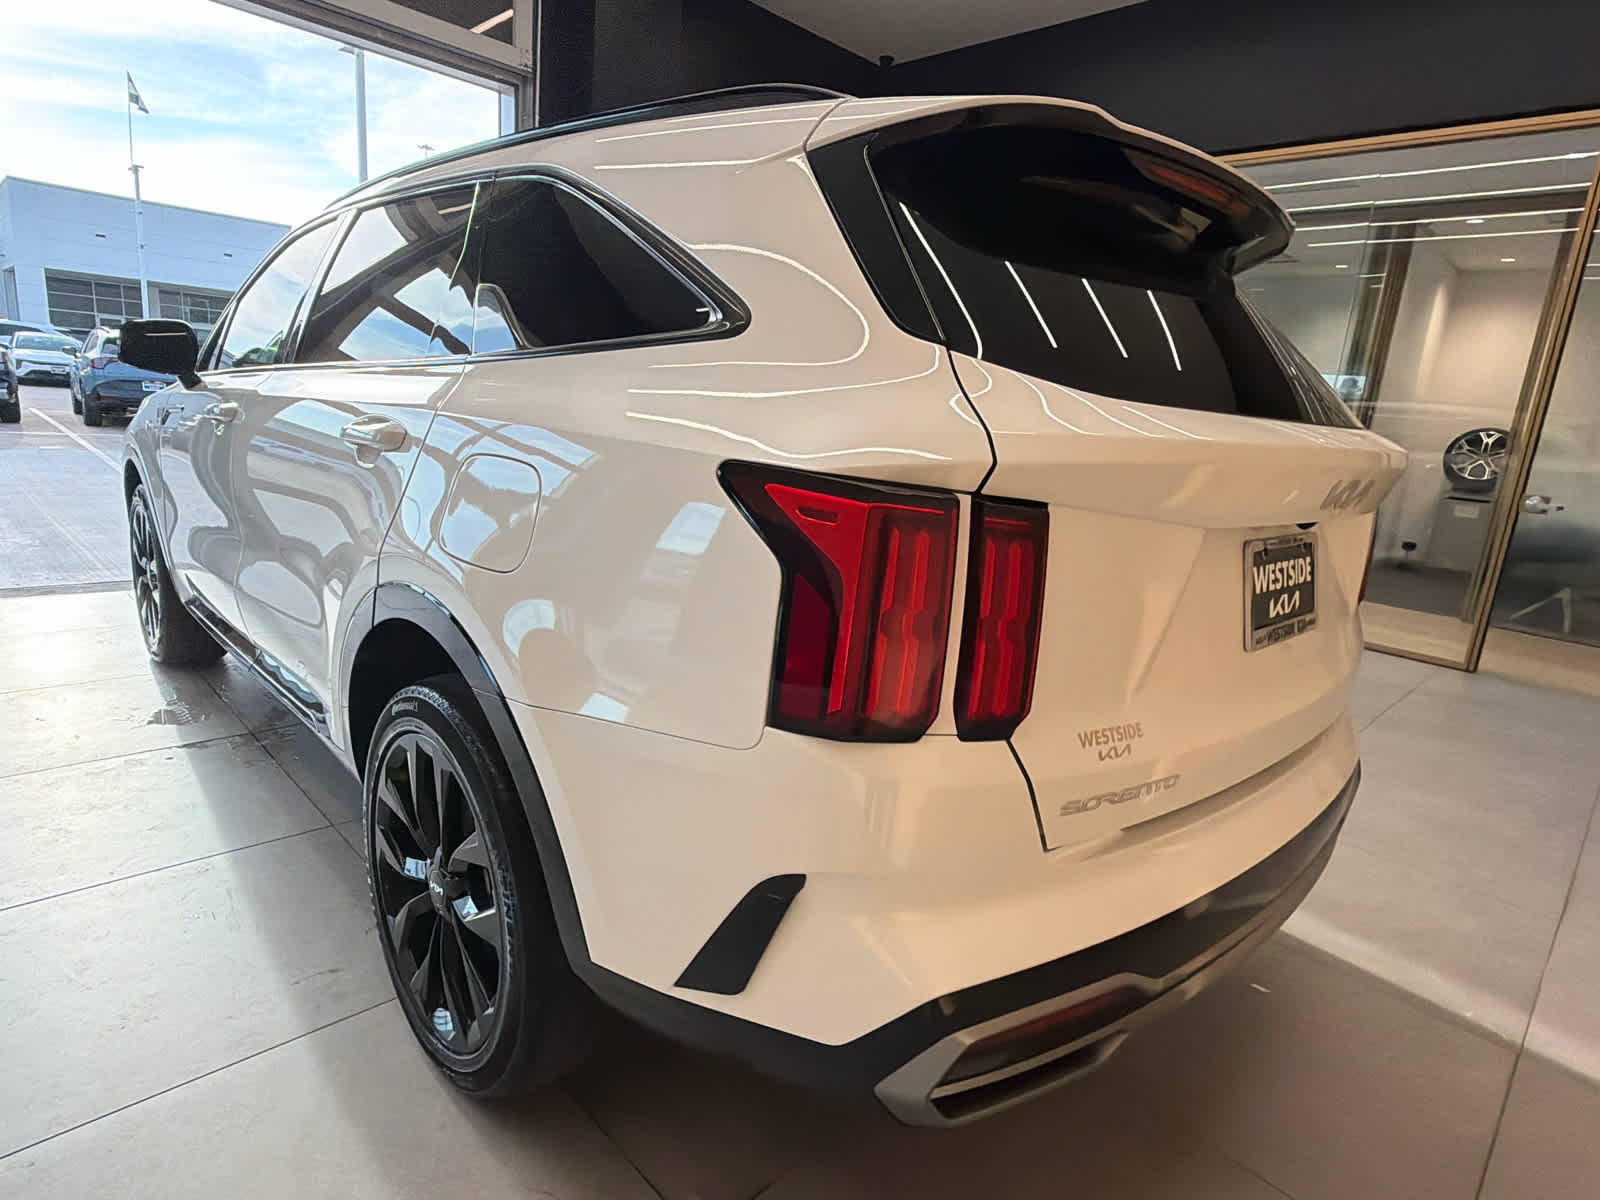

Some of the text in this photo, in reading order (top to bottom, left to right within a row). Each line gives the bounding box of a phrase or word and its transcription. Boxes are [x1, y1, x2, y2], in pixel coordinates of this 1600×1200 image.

[1252, 556, 1312, 594] WESTSIDE
[1268, 590, 1300, 618] KIA
[1078, 722, 1143, 749] WESTSIDE
[1098, 743, 1131, 762] KIA
[1060, 774, 1180, 816] SORENTO
